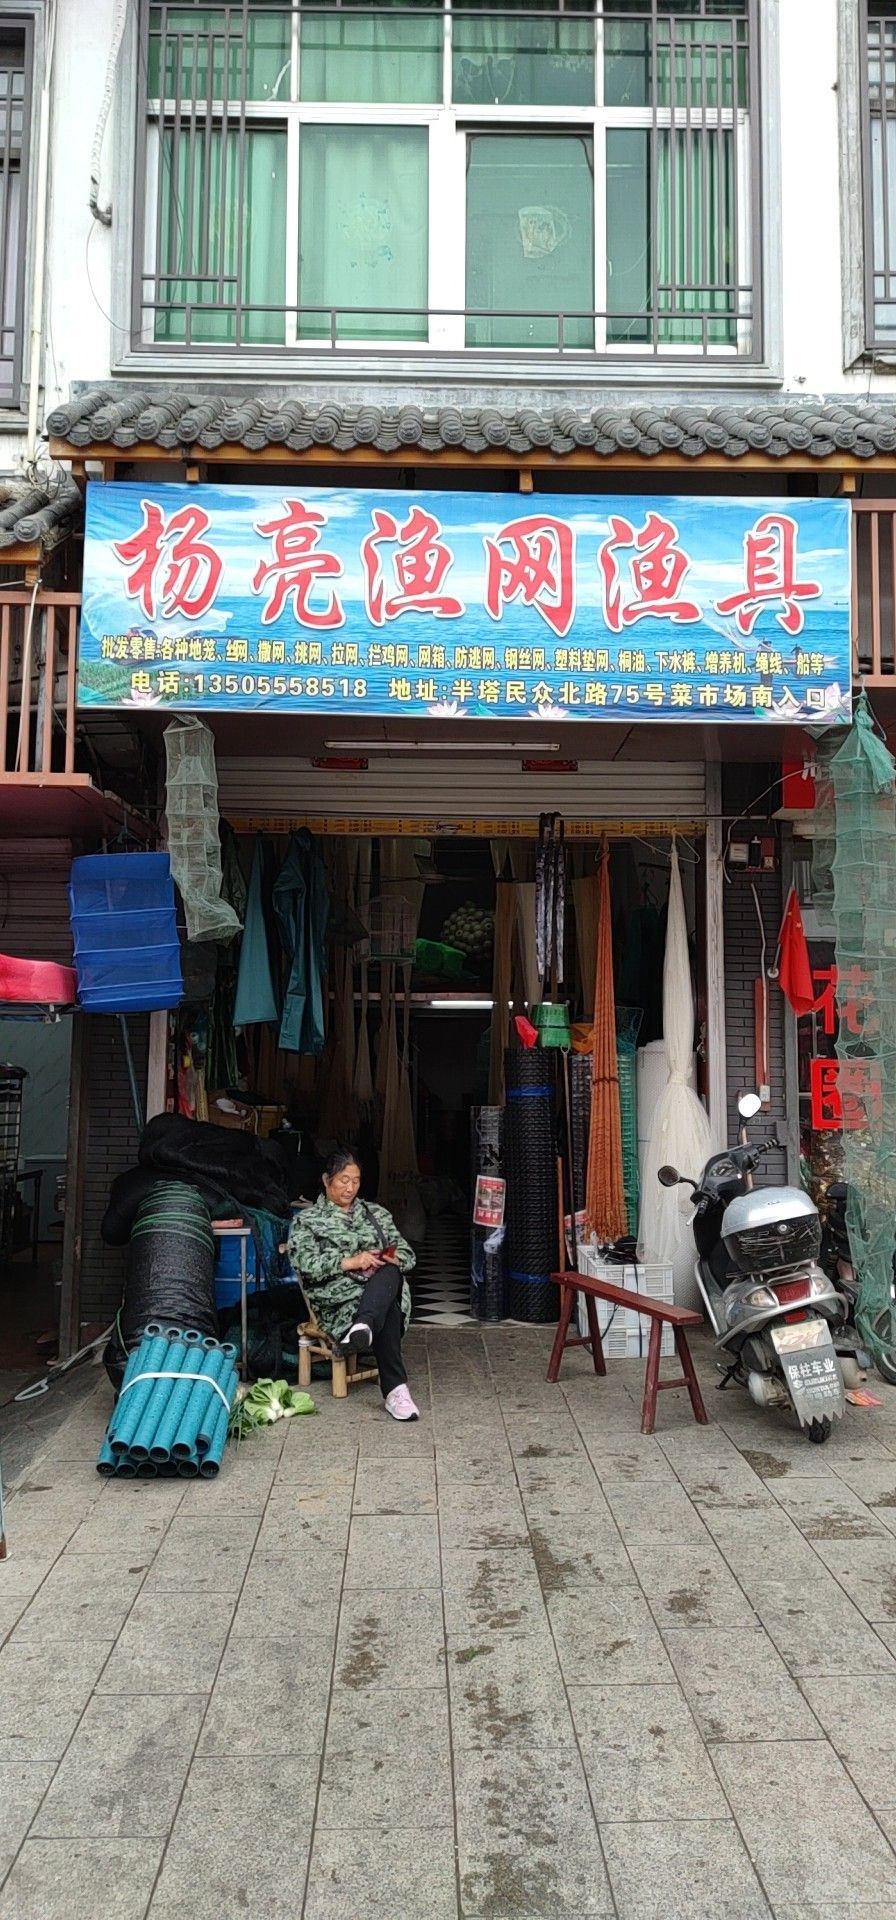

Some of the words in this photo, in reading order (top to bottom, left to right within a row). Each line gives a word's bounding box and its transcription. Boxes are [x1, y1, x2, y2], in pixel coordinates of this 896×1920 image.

[113, 498, 820, 637] 杨亮渔网渔具
